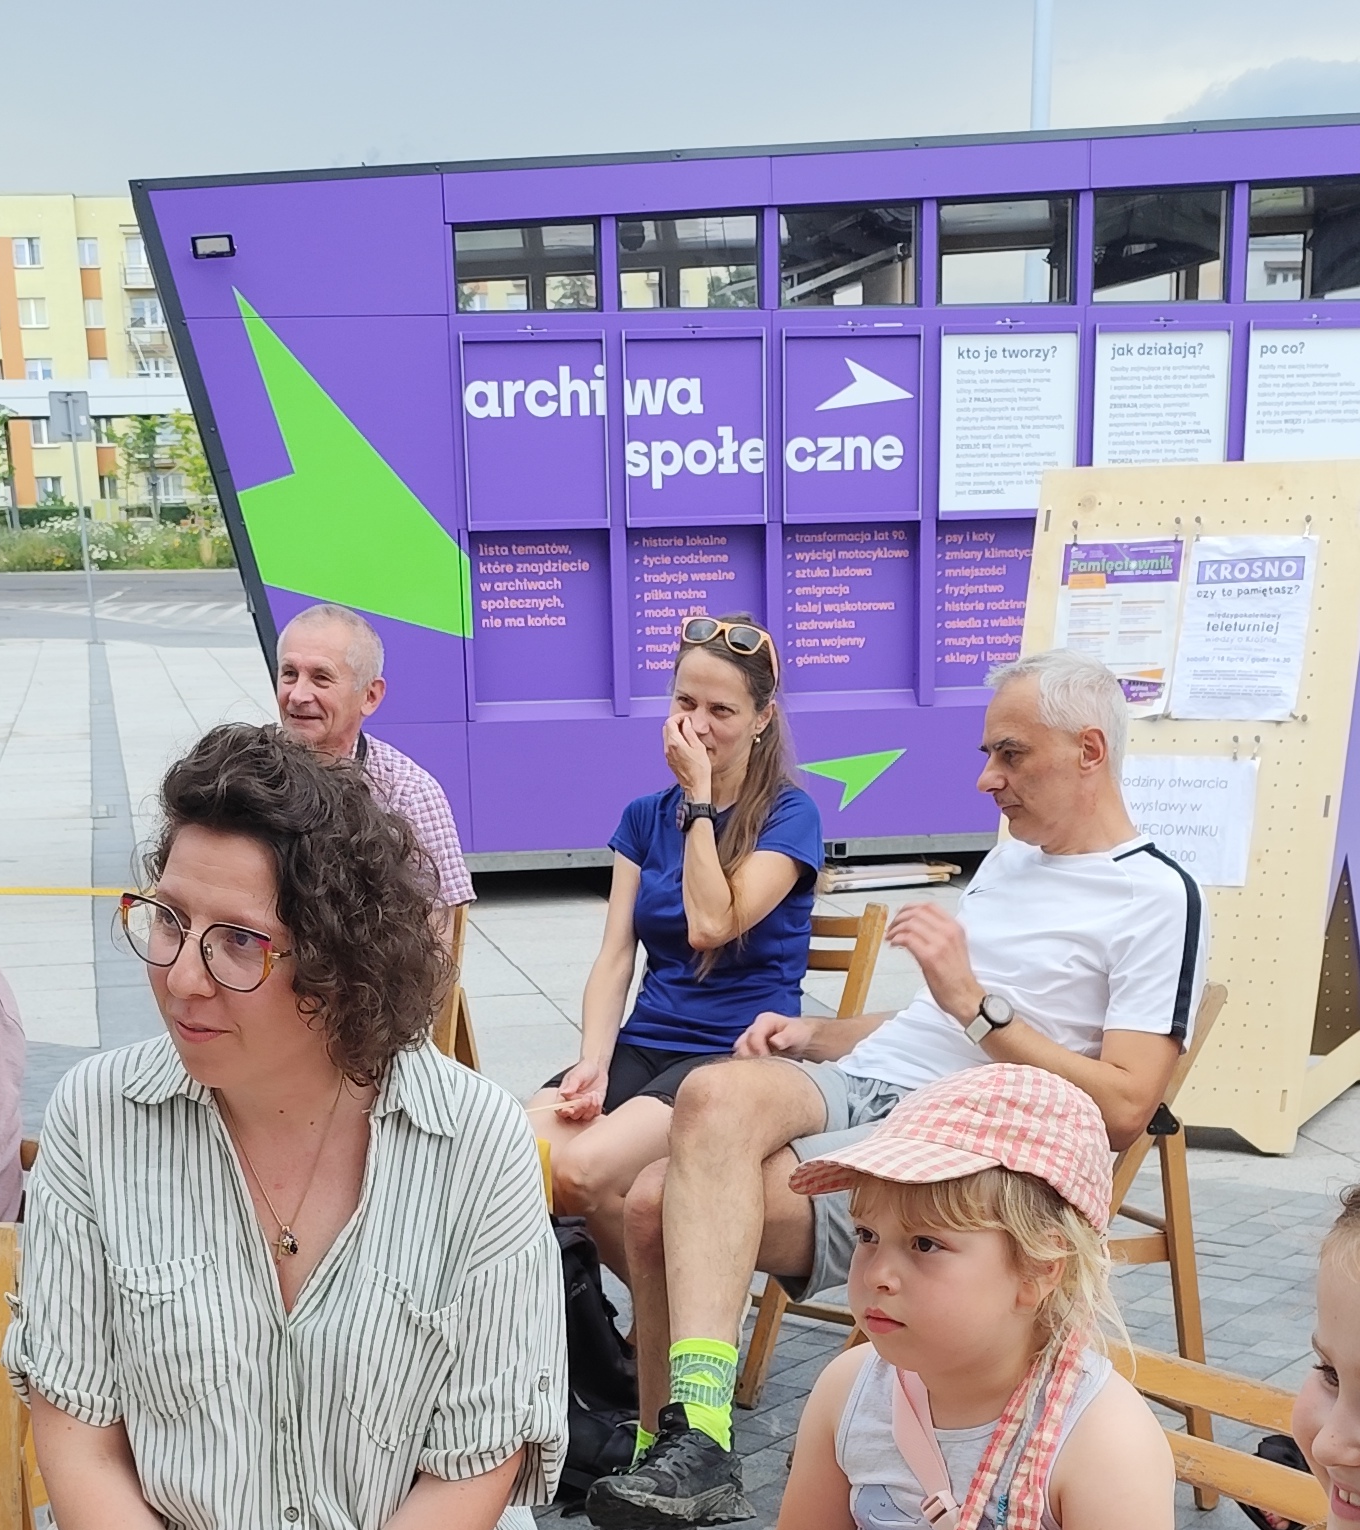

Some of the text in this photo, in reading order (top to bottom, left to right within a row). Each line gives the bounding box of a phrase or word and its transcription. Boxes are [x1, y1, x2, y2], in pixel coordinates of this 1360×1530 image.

[957, 346, 1058, 362] kto je tworzy?
[1111, 342, 1203, 360] jak działają?
[1260, 342, 1305, 358] po co?
[642, 535, 727, 547] historie lokalne
[795, 530, 907, 543] transformacja lat 90.
[945, 531, 995, 545] psy koty
[478, 543, 572, 556] lista tematów,
[795, 547, 909, 563] wyścigi motocyklowe
[945, 550, 982, 561] zmiany
[643, 550, 729, 567] życie codzienne
[479, 559, 590, 576] które znajdziecie
[795, 566, 872, 578] sztuka ludowa
[945, 565, 1006, 579] mniejszości
[1204, 560, 1297, 581] KROSNO
[644, 570, 735, 584] tradycje weselne
[480, 577, 562, 592] w archiwach
[796, 584, 850, 597] emigracja
[945, 583, 1004, 596] fryzjerstwo
[674, 588, 707, 600] nożna
[1197, 585, 1300, 599] czy to pamiętasz?
[481, 595, 564, 612] społecznych,
[795, 601, 895, 615] kolej wąskotorowa
[945, 599, 1026, 612] historie rodzinn
[645, 606, 709, 618] moda w PRL
[482, 614, 566, 628] nie ma końca
[796, 619, 855, 630] uzdrowiska
[1207, 621, 1280, 635] teleturniej
[796, 636, 866, 648] stan wojenny
[945, 634, 984, 648] muzyka
[796, 653, 850, 667] górnictwo
[945, 652, 978, 664] sklepy
[1122, 776, 1228, 790] odziny otwarcia
[1130, 801, 1203, 814] wystawy w
